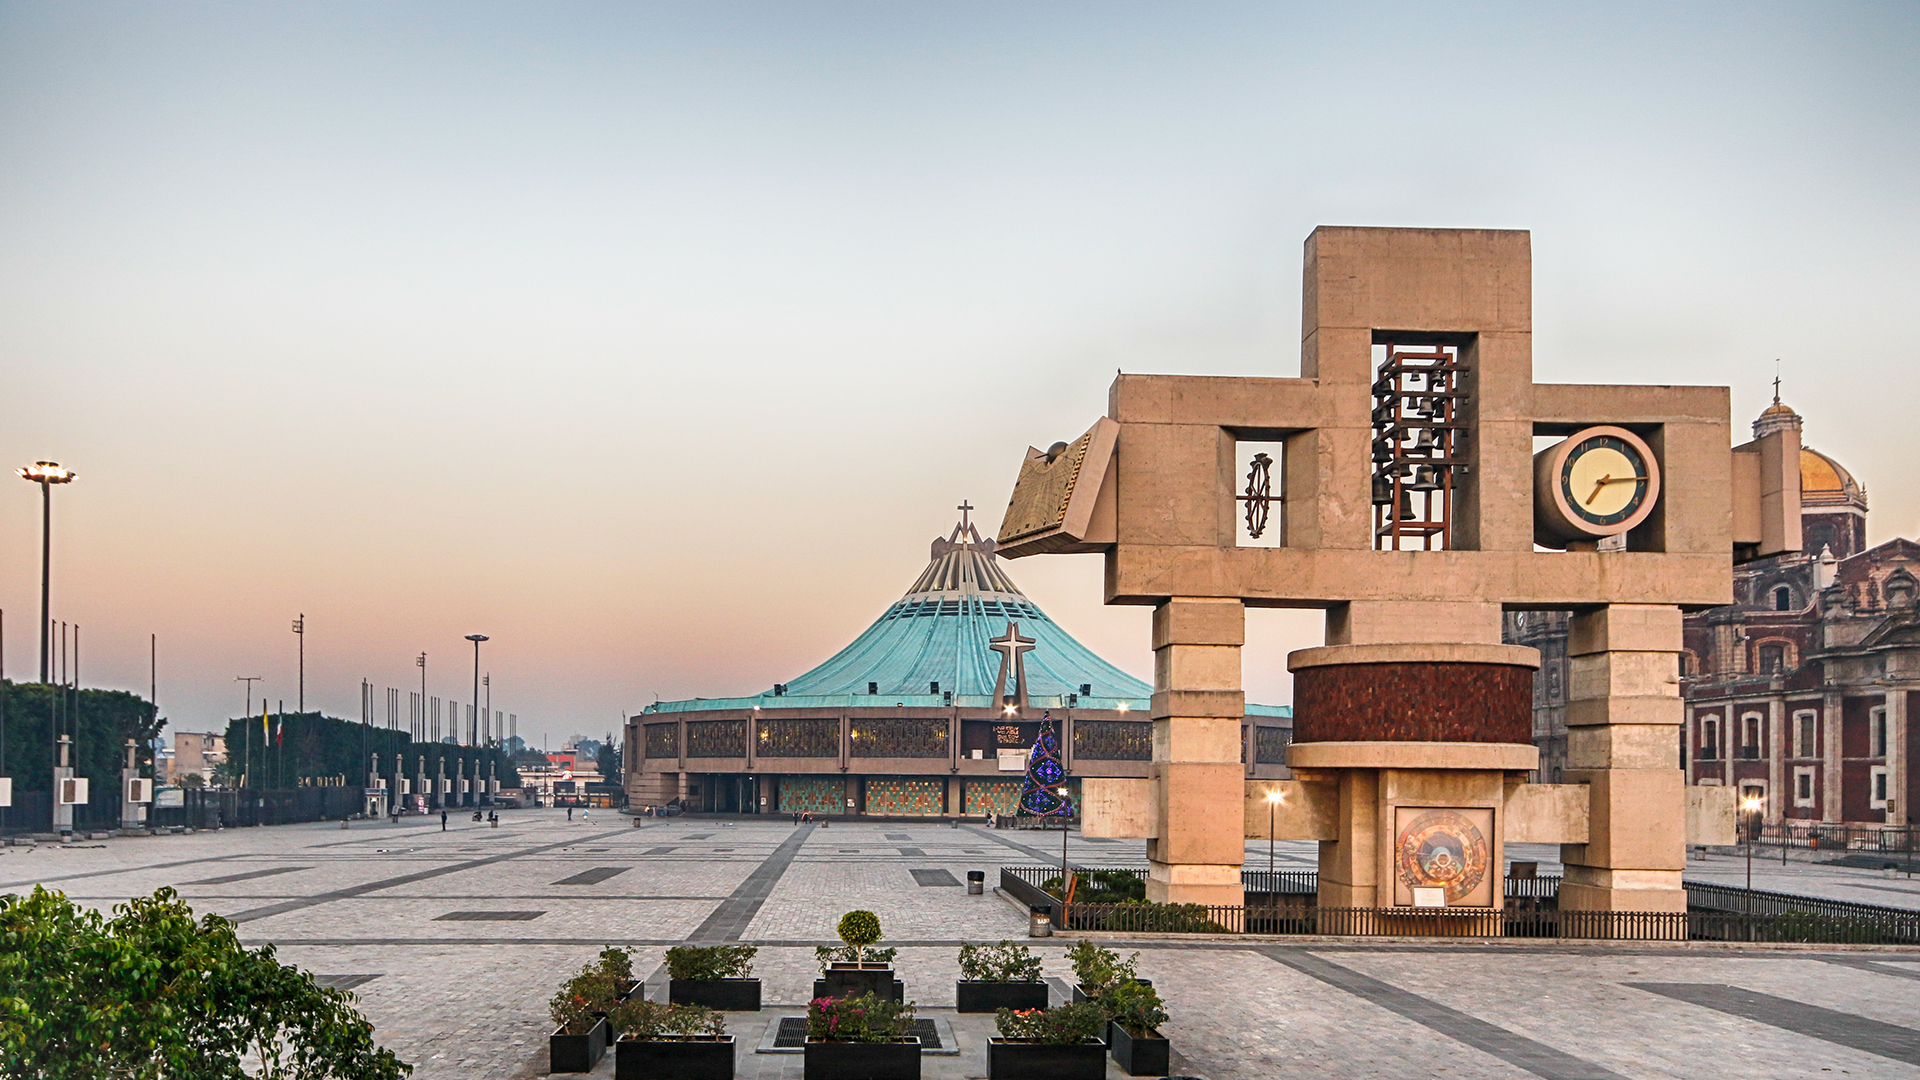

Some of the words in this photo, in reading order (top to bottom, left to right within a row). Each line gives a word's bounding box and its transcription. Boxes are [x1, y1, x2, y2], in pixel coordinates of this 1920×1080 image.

[1580, 442, 1589, 453] 11
[1599, 437, 1609, 448] 12
[1565, 457, 1575, 467] 10
[1633, 457, 1640, 467] 2
[1561, 475, 1568, 486] 9
[1567, 496, 1573, 506] 8
[1632, 496, 1638, 506] 4
[1581, 511, 1587, 520] 7
[1599, 515, 1607, 525] 6
